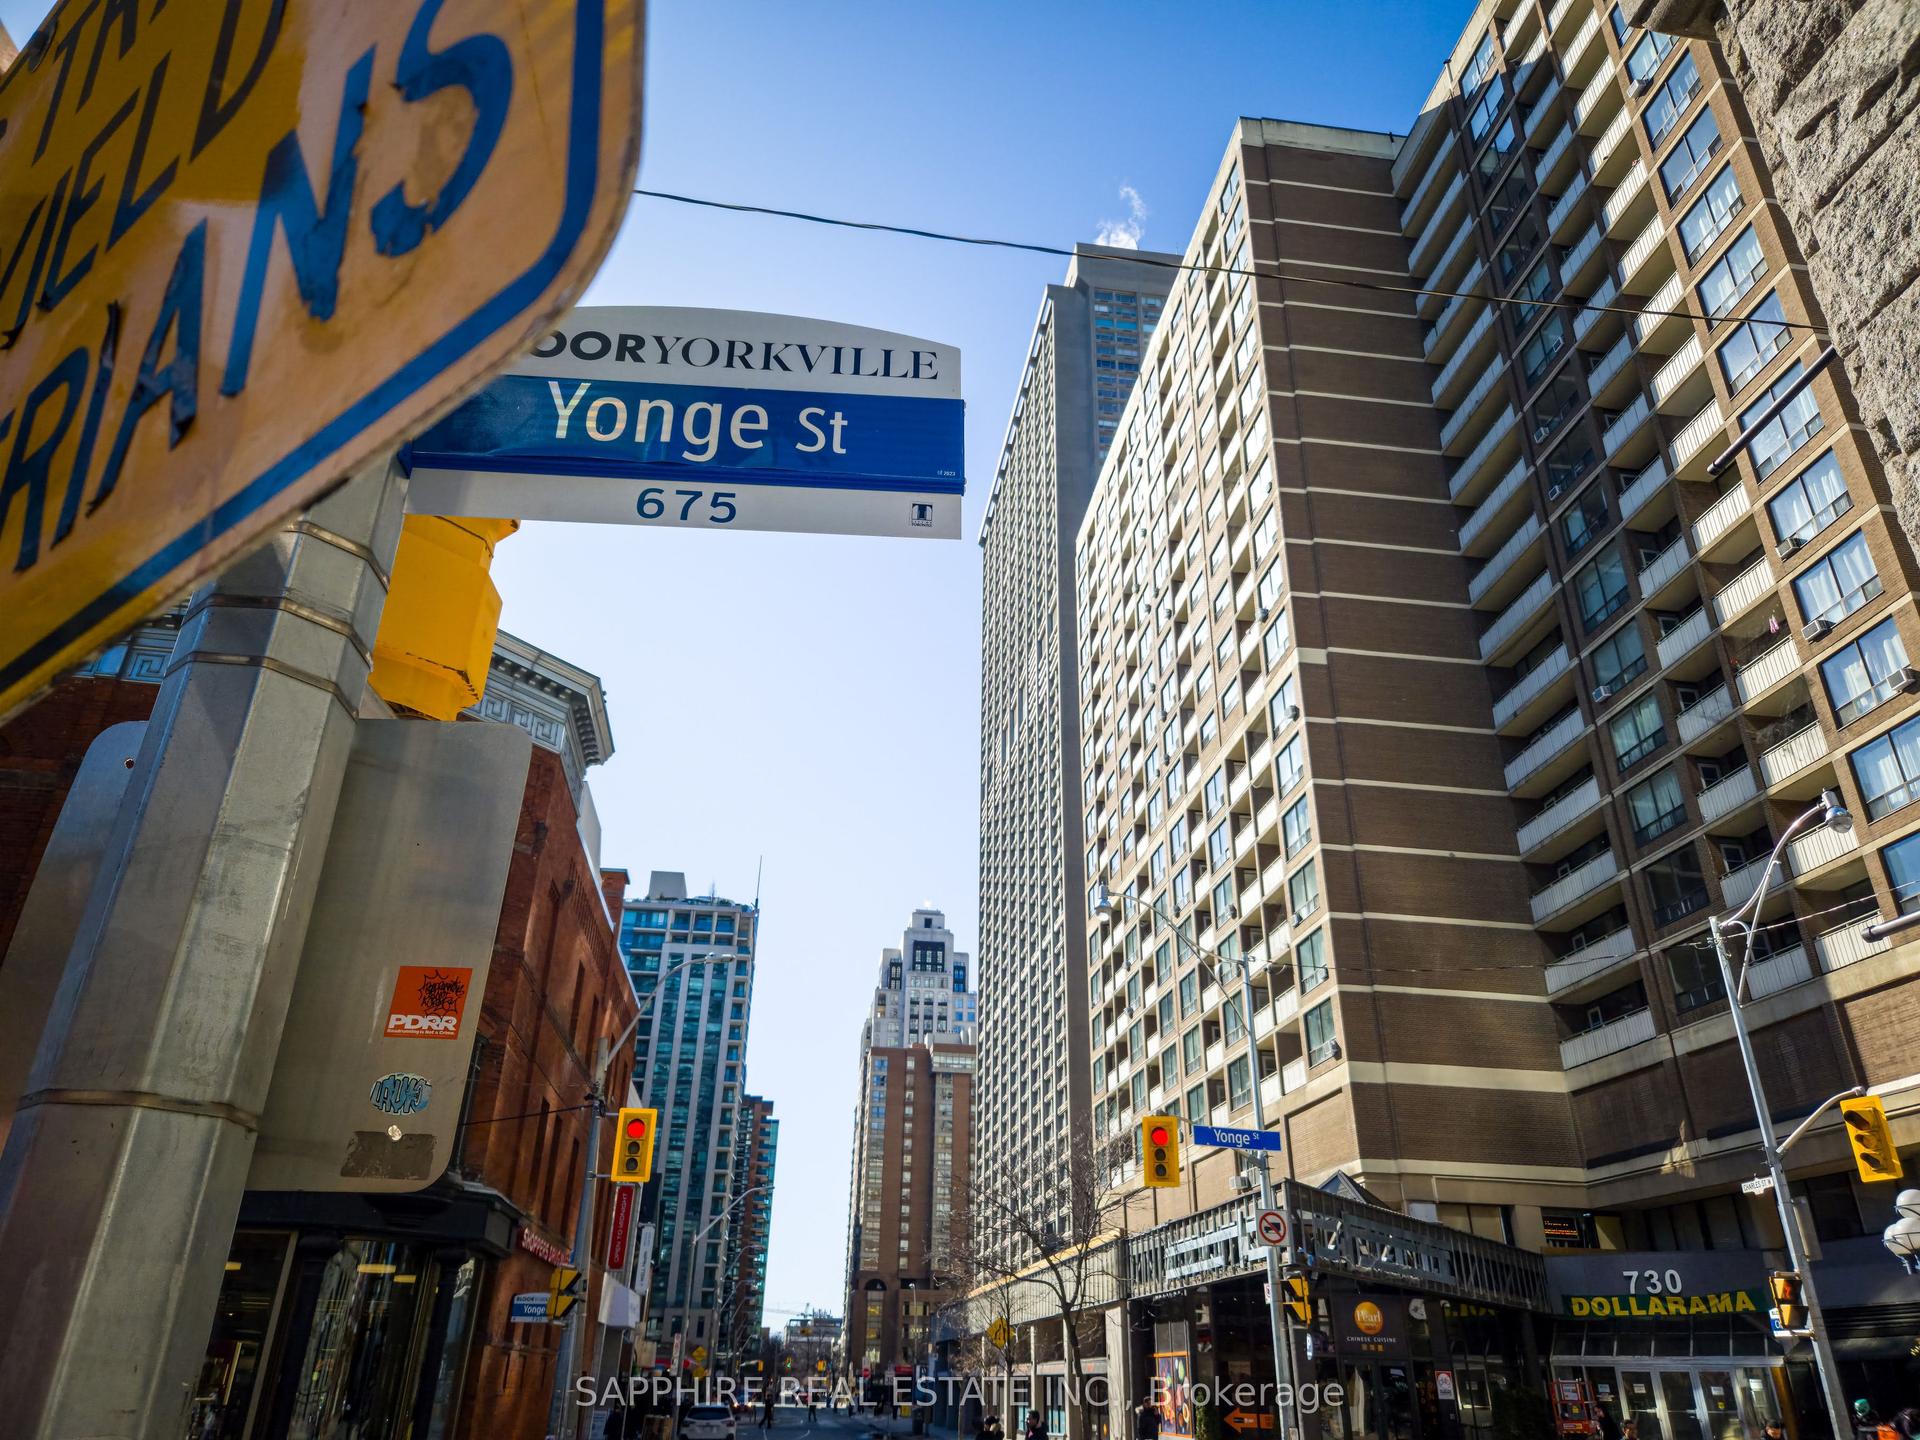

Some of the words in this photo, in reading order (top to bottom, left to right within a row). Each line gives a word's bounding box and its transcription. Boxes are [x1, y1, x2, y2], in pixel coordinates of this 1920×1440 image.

[547, 380, 769, 463] Yonge
[795, 407, 848, 455] St
[636, 487, 737, 524] 675
[387, 1014, 457, 1031] PDRR
[1213, 1128, 1251, 1148] Yonge
[1252, 1132, 1260, 1140] St
[1743, 1181, 1761, 1192] CHARLES
[618, 1192, 628, 1226] MIDNIGHT
[617, 1226, 625, 1240] TO
[613, 1241, 622, 1263] OPEN
[1623, 1269, 1682, 1295] 730
[523, 1305, 546, 1315] Yonge
[1571, 1291, 1756, 1317] DOLLARAMA
[1346, 1335, 1371, 1343] CHINESE
[1373, 1335, 1397, 1343] CUISINE
